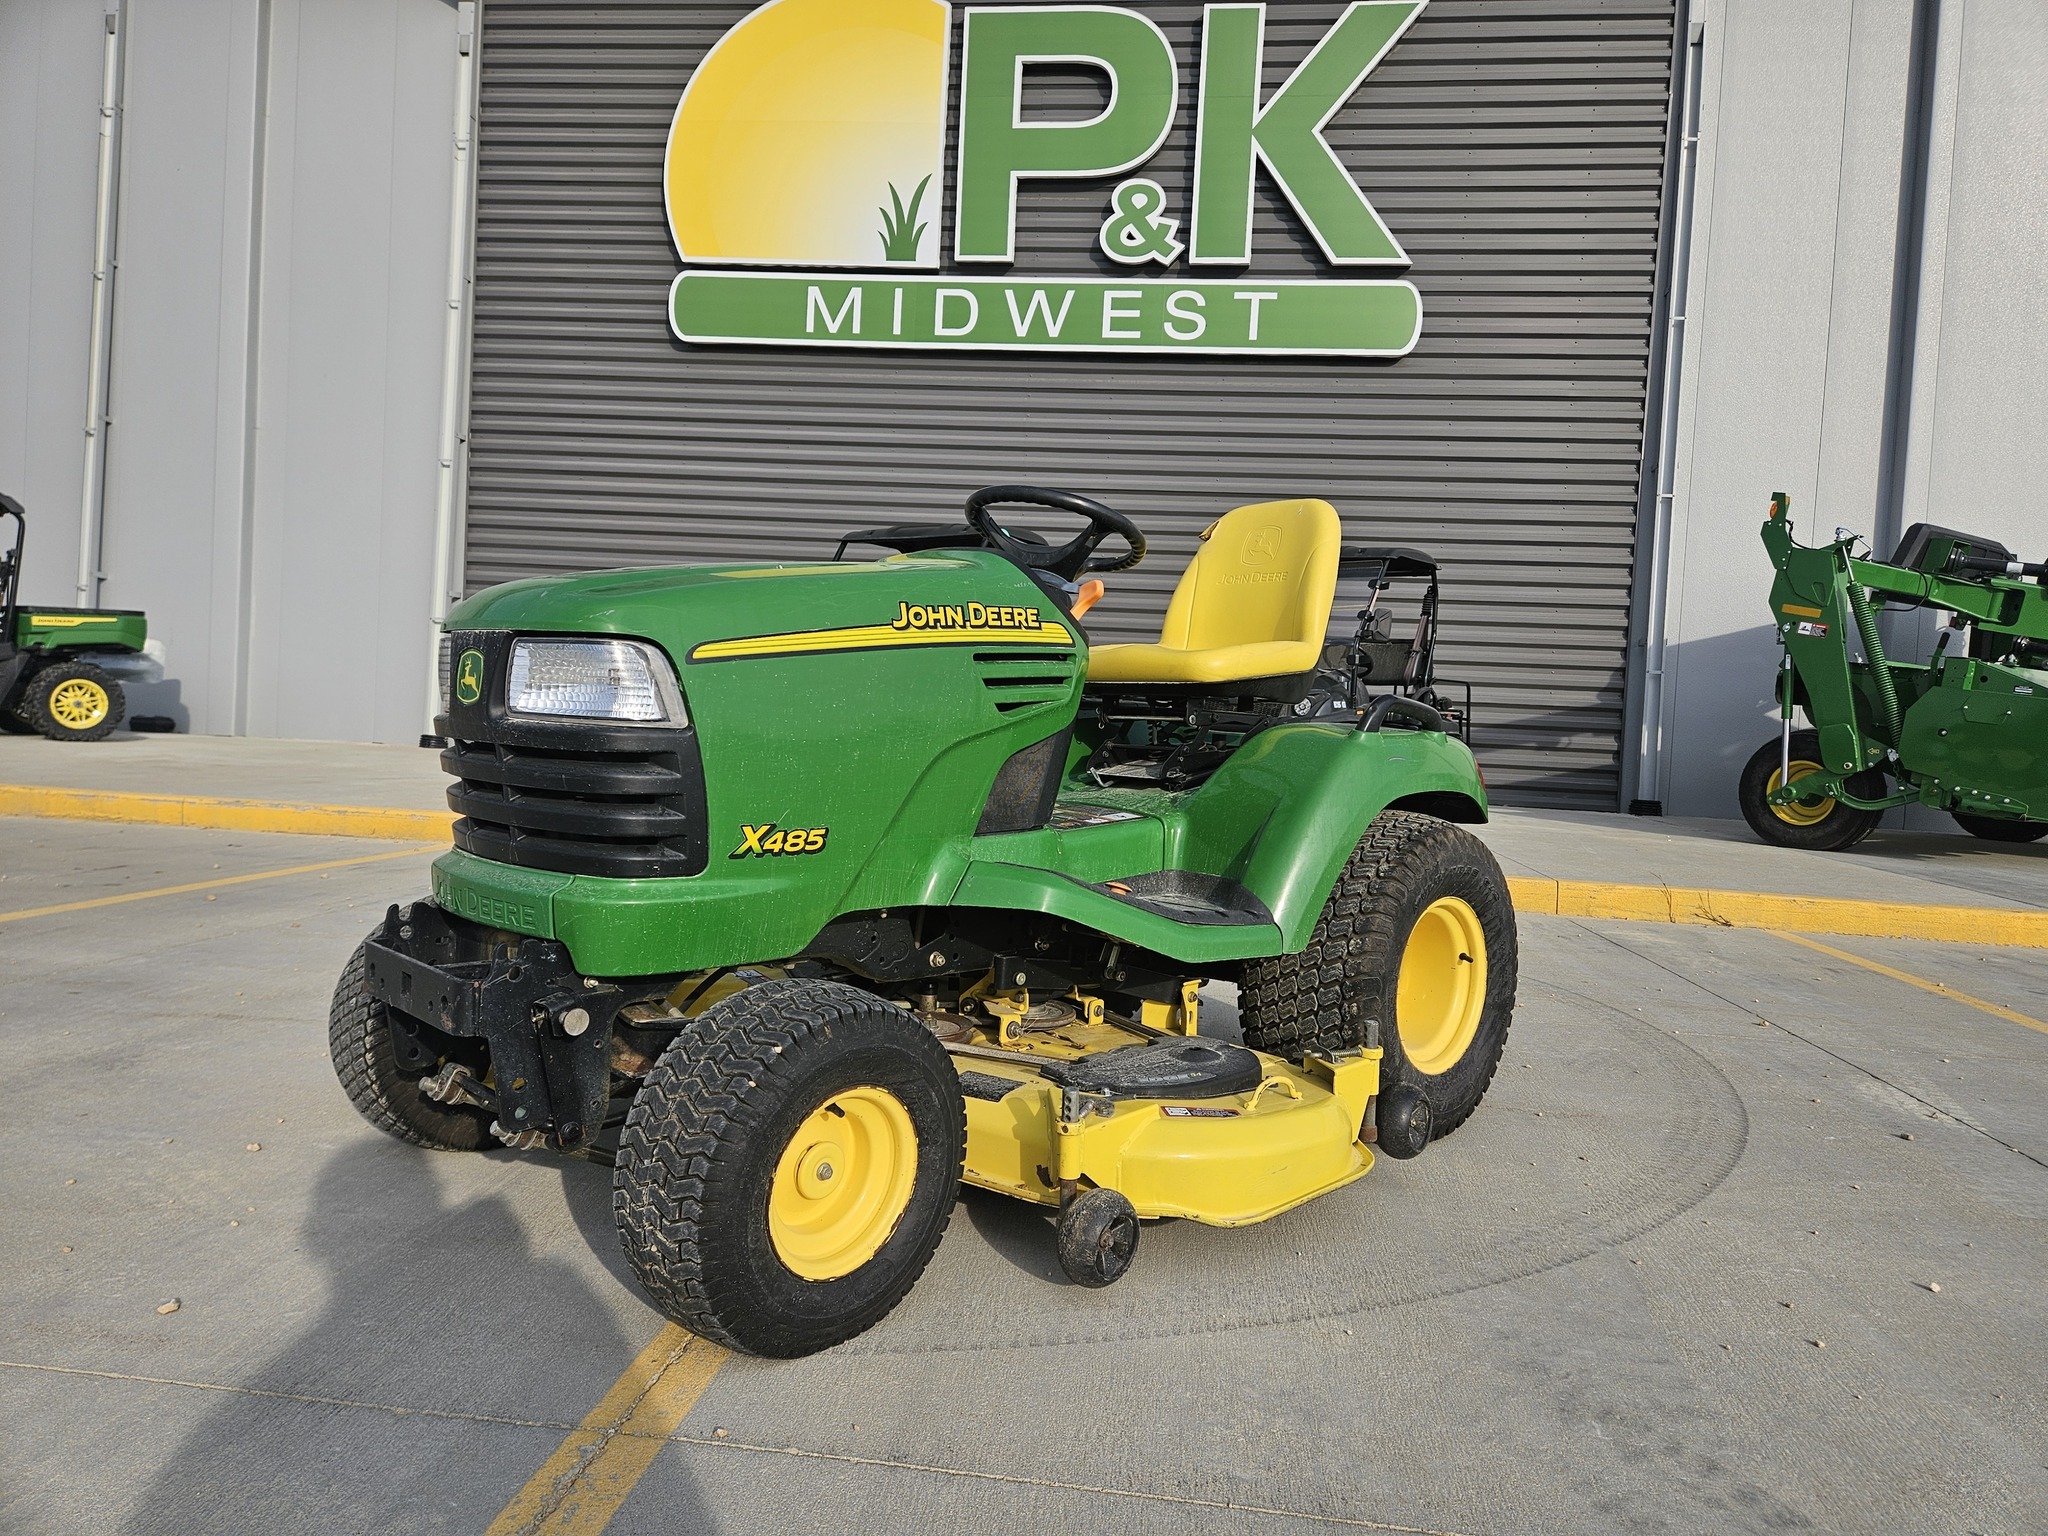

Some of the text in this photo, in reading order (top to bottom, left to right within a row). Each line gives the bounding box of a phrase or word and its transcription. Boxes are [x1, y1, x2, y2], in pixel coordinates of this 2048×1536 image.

[804, 285, 1279, 342] MIDWEST
[1215, 571, 1289, 585] JOHN DEERE
[892, 601, 1042, 630] JOHN DEERE
[729, 823, 829, 859] X485
[464, 887, 536, 930] DEERE
